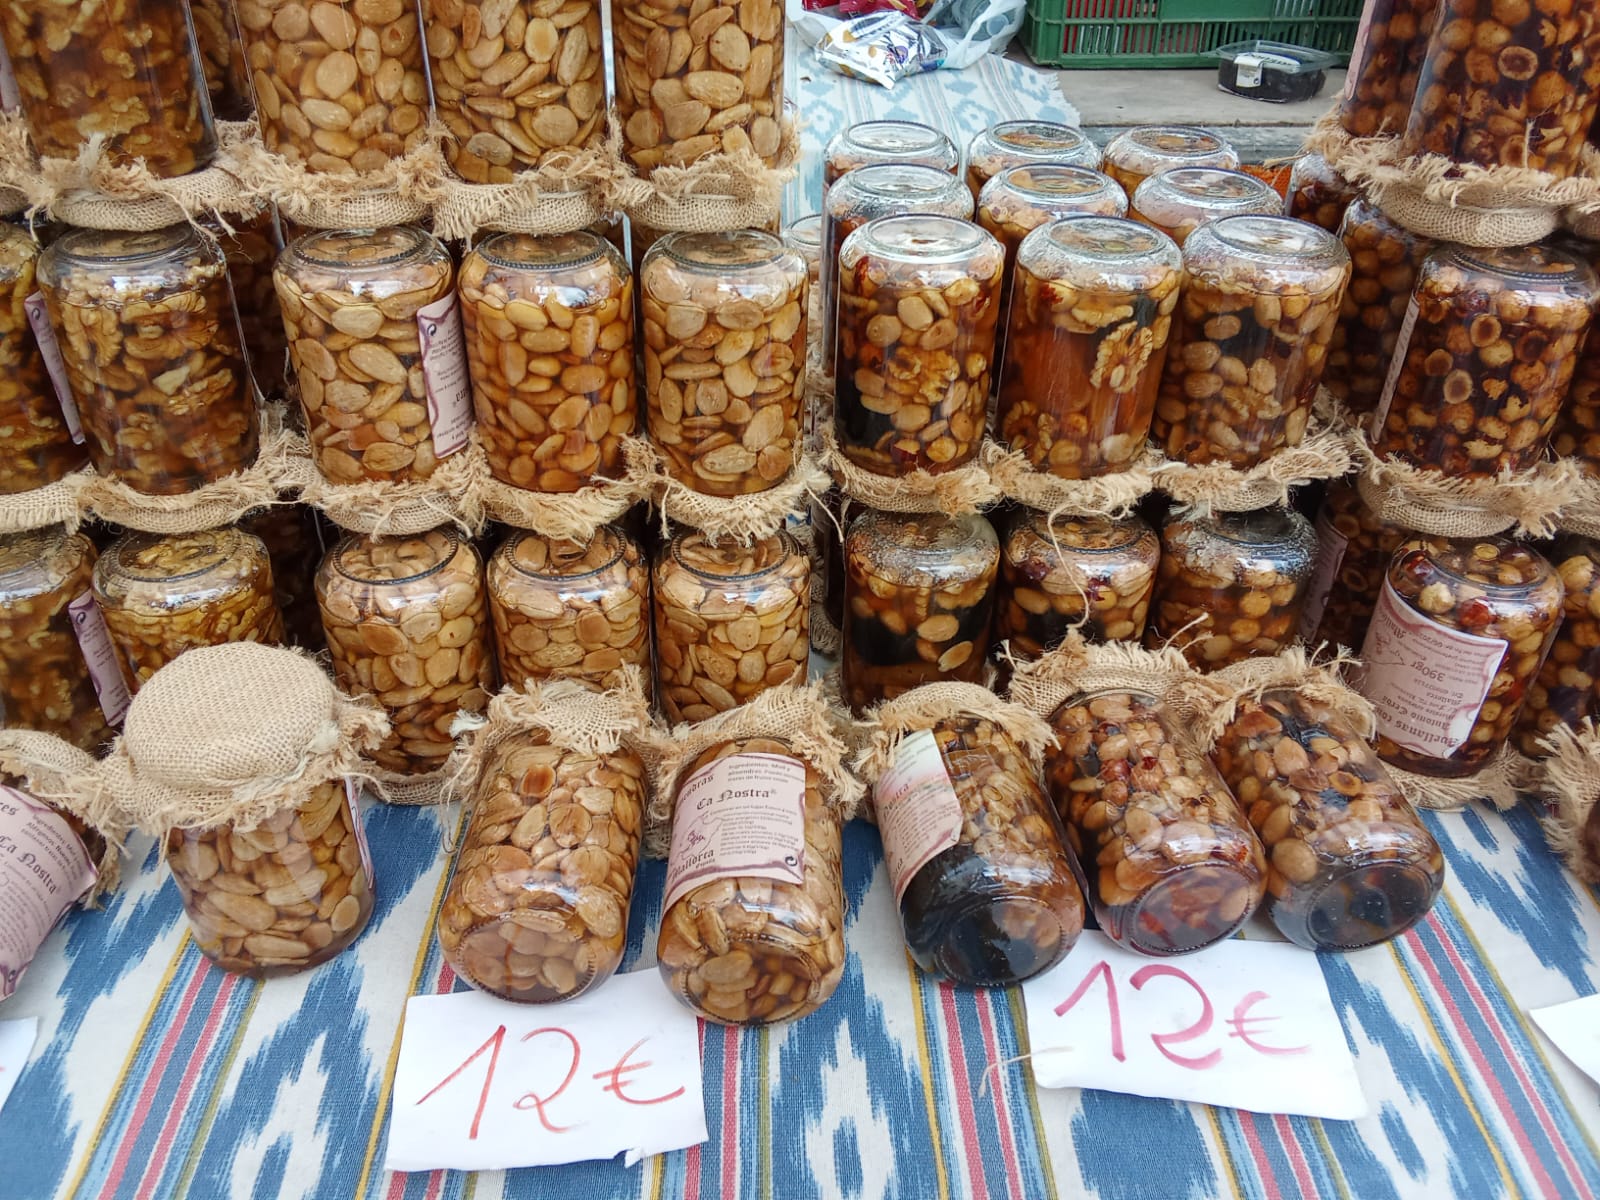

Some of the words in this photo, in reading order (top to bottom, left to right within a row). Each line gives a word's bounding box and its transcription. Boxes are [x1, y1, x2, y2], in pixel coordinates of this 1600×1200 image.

[1410, 661, 1446, 683] 390gr
[1395, 720, 1460, 748] Avellanas
[1411, 713, 1452, 730] Antonio
[1054, 960, 1312, 1070] 12€
[416, 1024, 686, 1140] 12€
